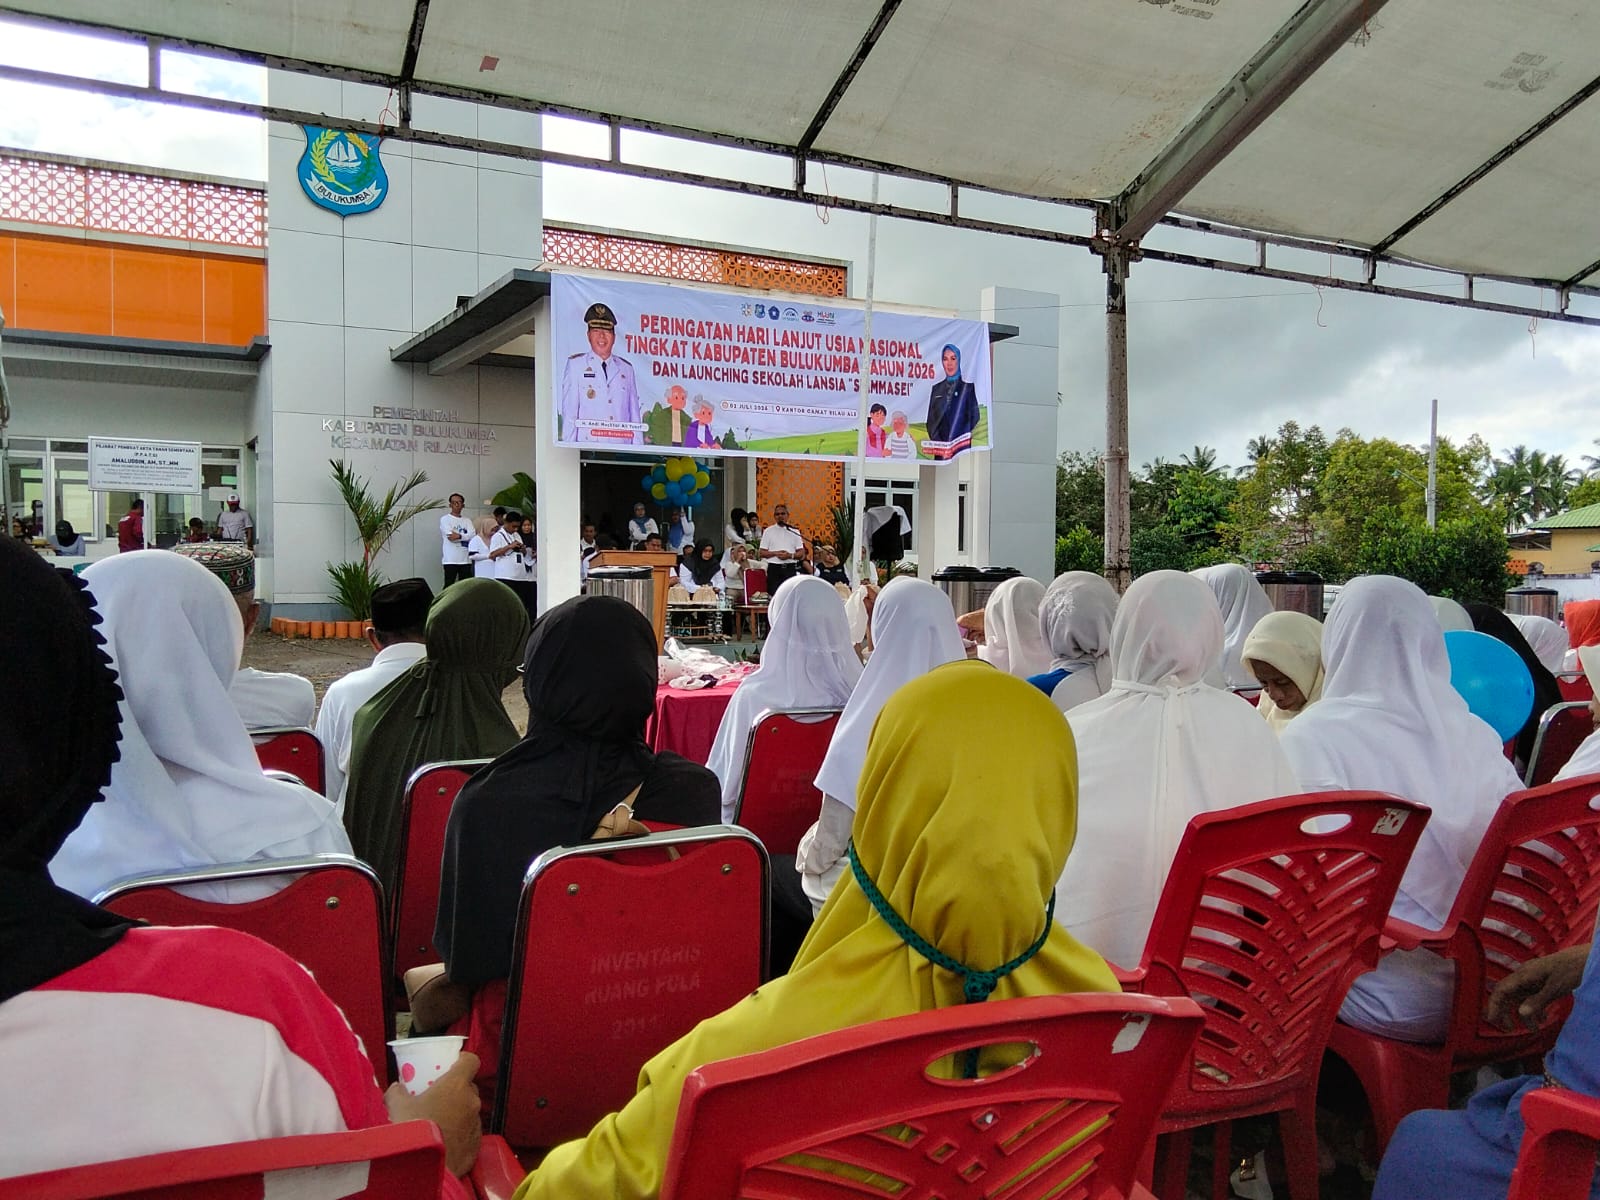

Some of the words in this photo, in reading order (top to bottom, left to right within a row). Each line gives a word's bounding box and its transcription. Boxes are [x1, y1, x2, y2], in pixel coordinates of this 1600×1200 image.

[317, 185, 371, 204] BULUKUMBA
[640, 314, 733, 341] PERINGATAN
[737, 325, 769, 346] HARI
[773, 328, 822, 350] LANJUT
[825, 334, 856, 354] USIA
[625, 334, 688, 358] TINGKAT
[692, 342, 777, 367] KABUPATEN
[780, 350, 860, 375] BULUKUMBA
[869, 359, 904, 378] AHUN
[908, 362, 935, 380] 2026
[652, 361, 679, 378] DAN
[682, 364, 749, 384] LAUNCHING
[752, 370, 804, 389] SEKOLAH
[807, 375, 846, 391] LANSIA
[373, 406, 459, 422] PEMERINTAH
[781, 406, 805, 414] KANTOR
[322, 418, 408, 436] KABUPATEN
[412, 423, 497, 441] BULUKUMBA
[331, 435, 418, 452] KECAMATAN
